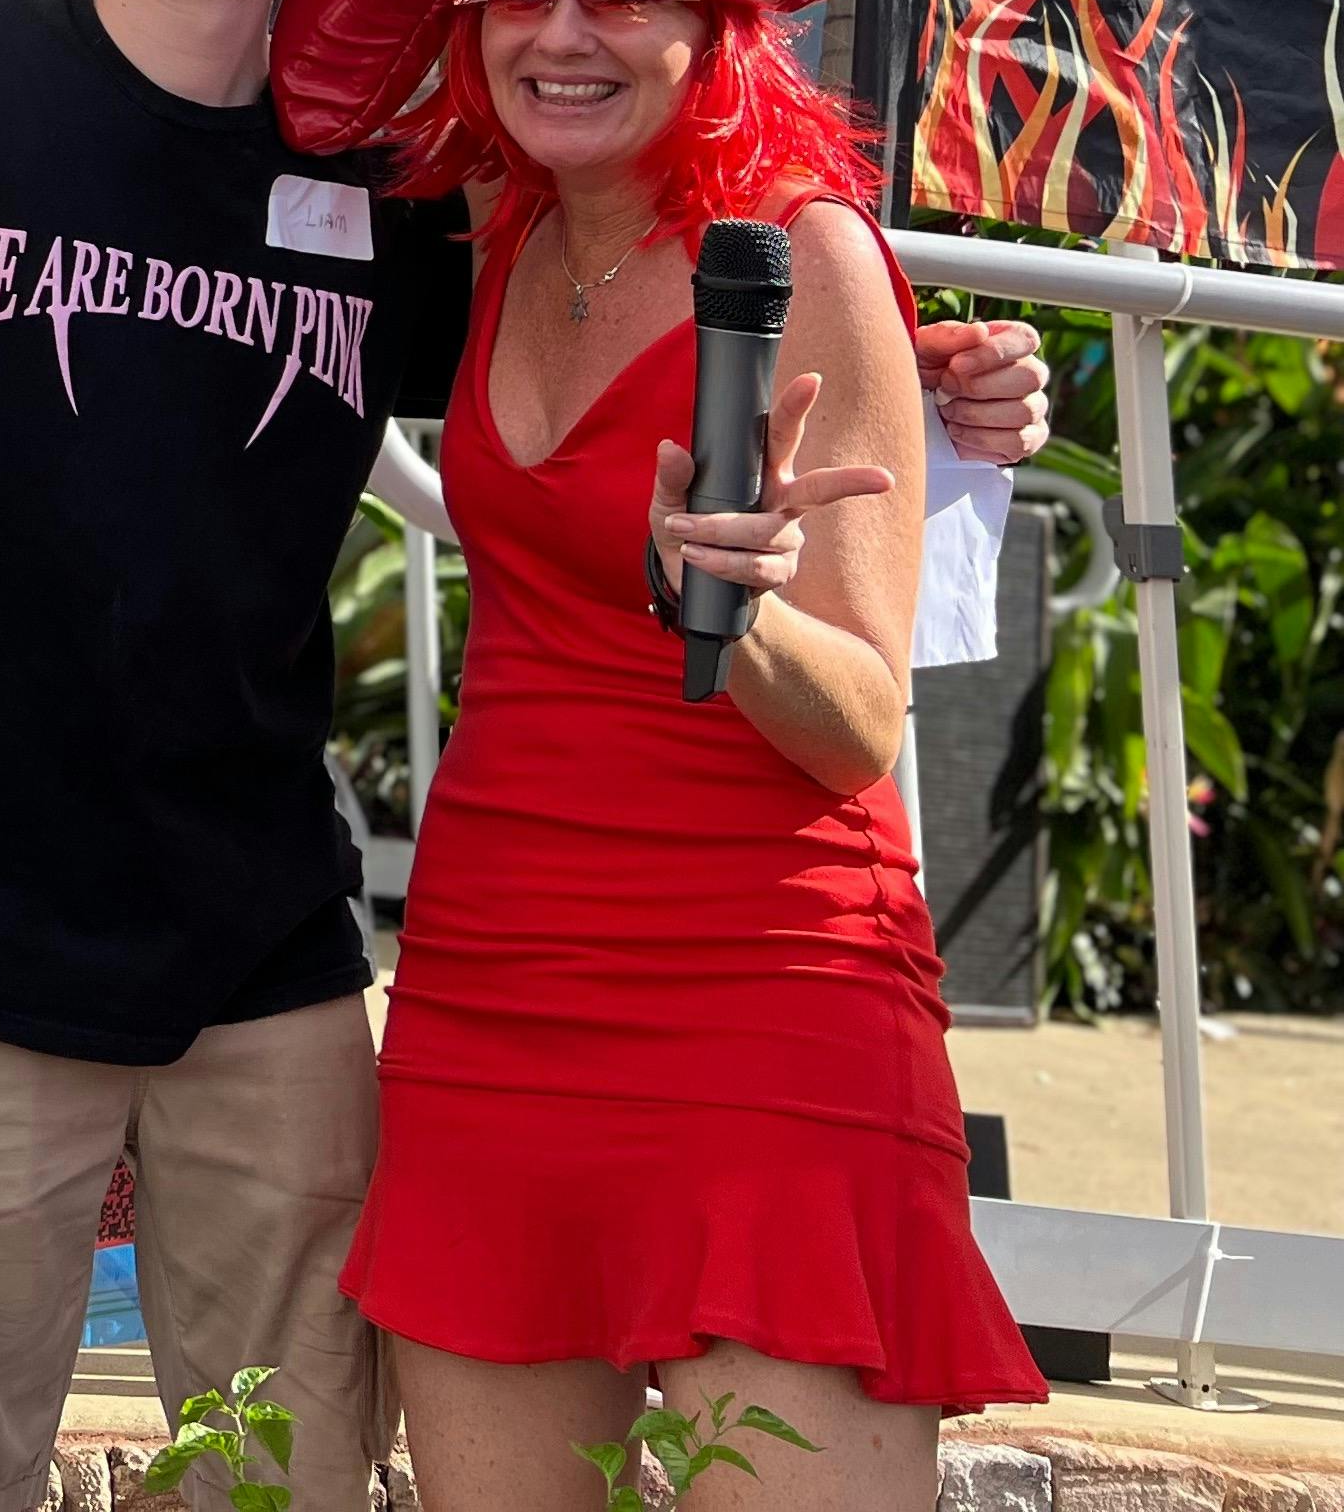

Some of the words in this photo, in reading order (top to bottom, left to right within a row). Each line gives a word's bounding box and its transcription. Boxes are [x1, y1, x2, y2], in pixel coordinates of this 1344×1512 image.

[304, 204, 348, 234] LIAM
[138, 257, 286, 355] BORN
[243, 285, 374, 451] PINK
